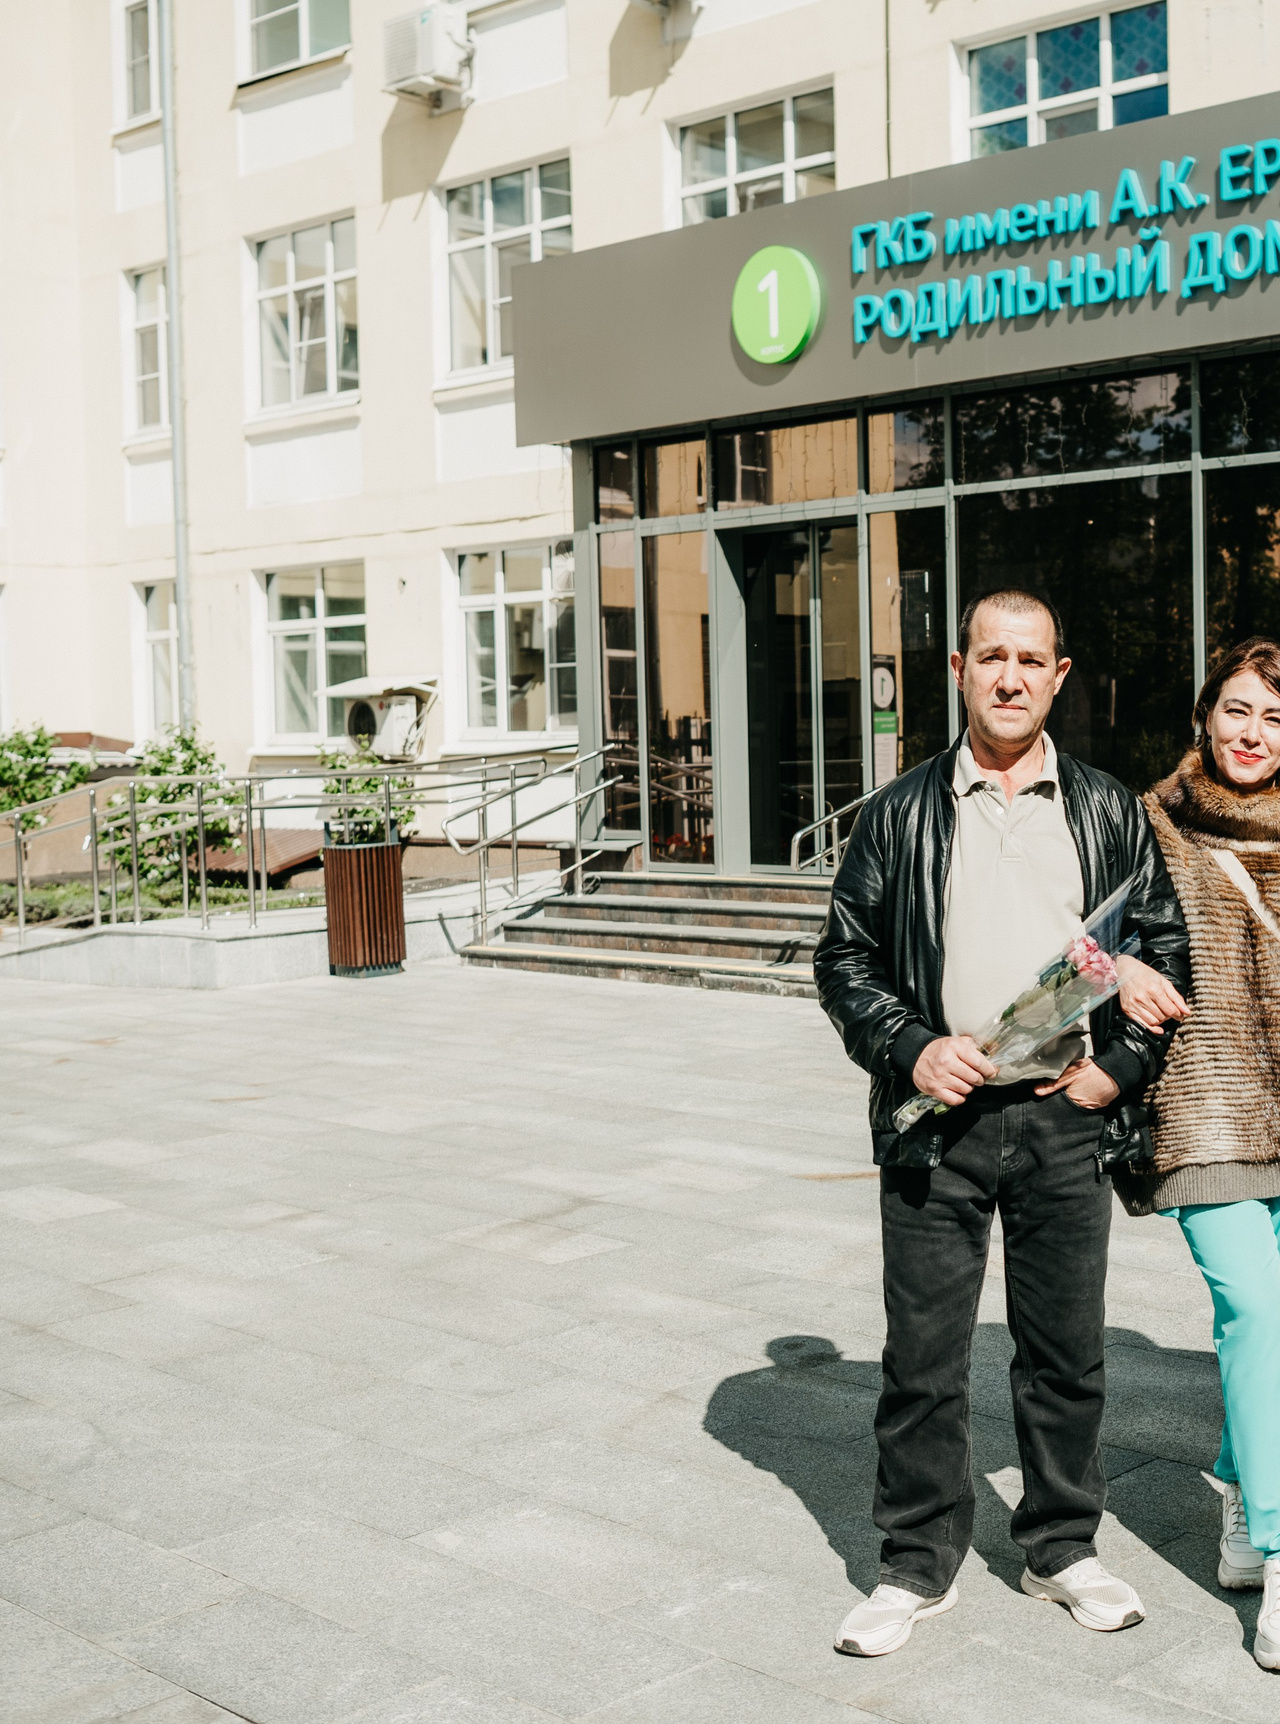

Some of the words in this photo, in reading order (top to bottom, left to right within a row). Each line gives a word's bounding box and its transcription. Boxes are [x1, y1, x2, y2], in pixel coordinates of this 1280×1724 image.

[852, 211, 935, 273] ГКБ
[945, 190, 1099, 256] имени
[1109, 156, 1209, 224] А.К.
[757, 269, 779, 339] 1
[853, 226, 1170, 343] РОДИЛЬНЫЙ
